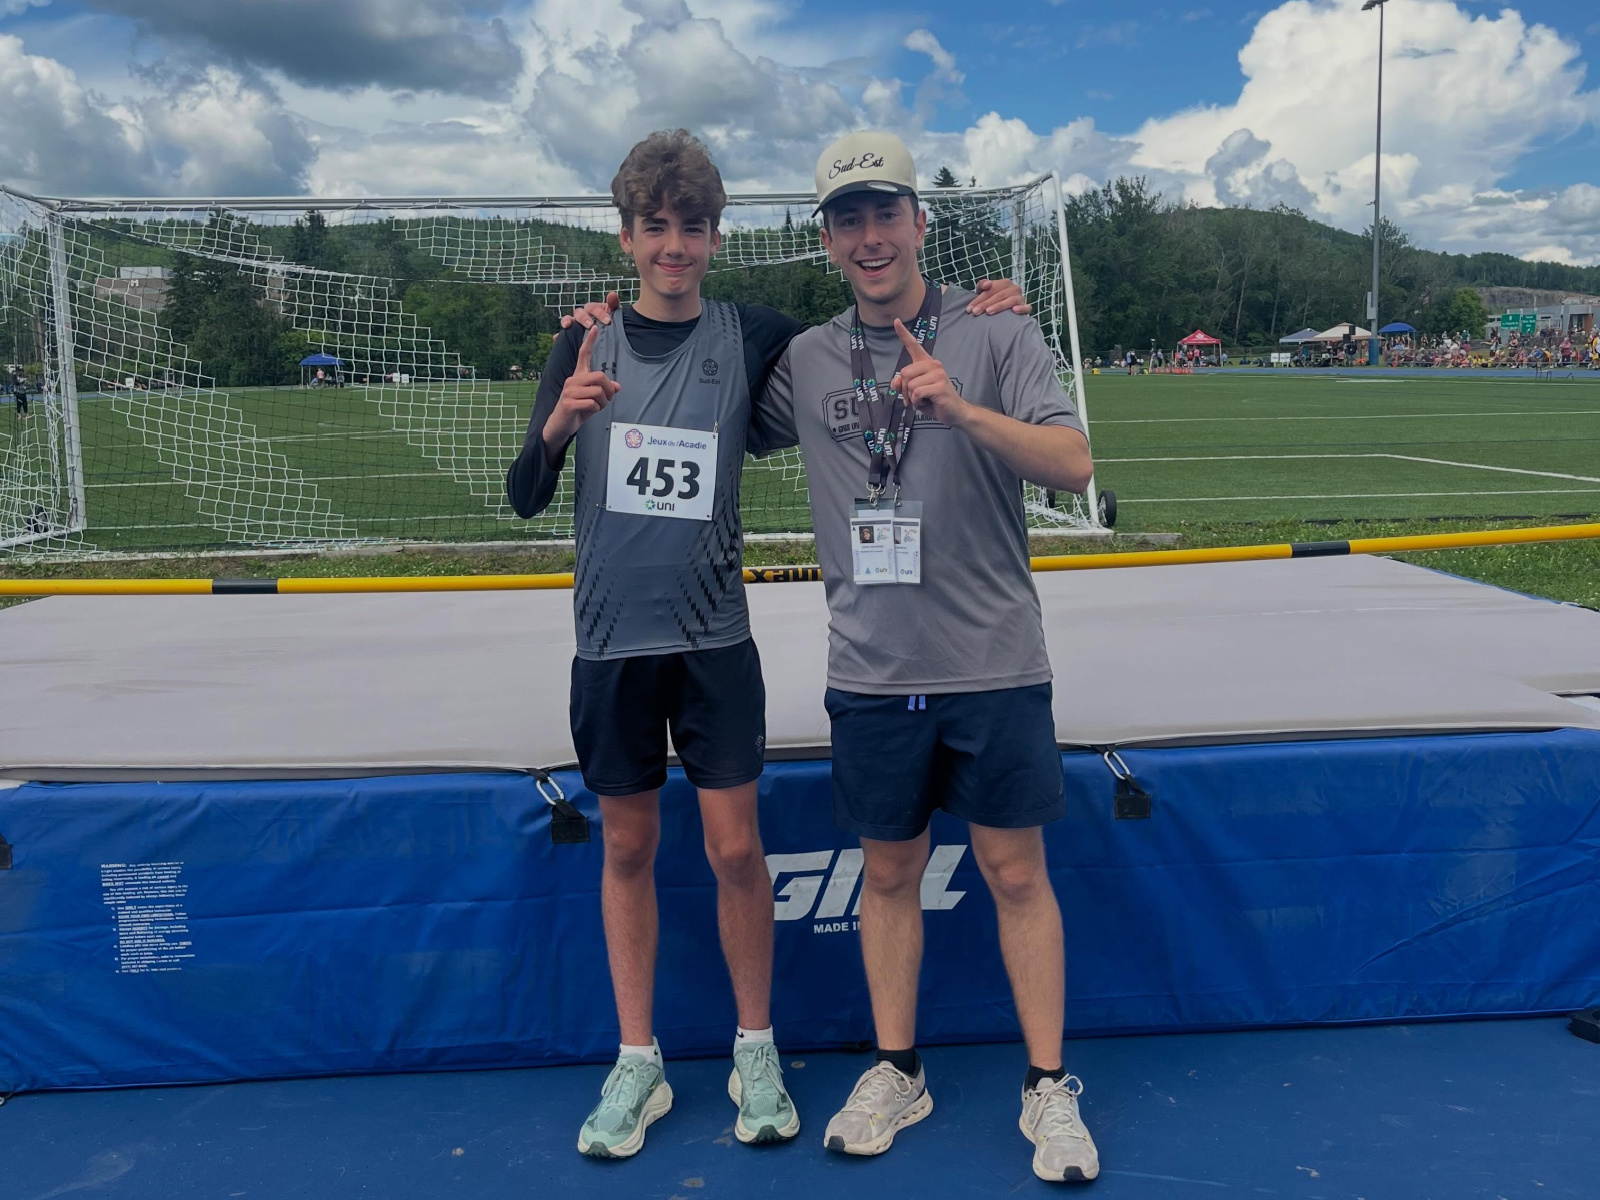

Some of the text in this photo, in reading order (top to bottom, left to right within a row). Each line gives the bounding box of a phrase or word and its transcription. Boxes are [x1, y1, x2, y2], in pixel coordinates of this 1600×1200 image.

[828, 152, 884, 180] Sud-Est
[647, 436, 668, 445] Jeux
[626, 457, 701, 500] 453
[657, 501, 676, 512] uni
[764, 844, 968, 921] GIL
[813, 921, 849, 934] MADE
